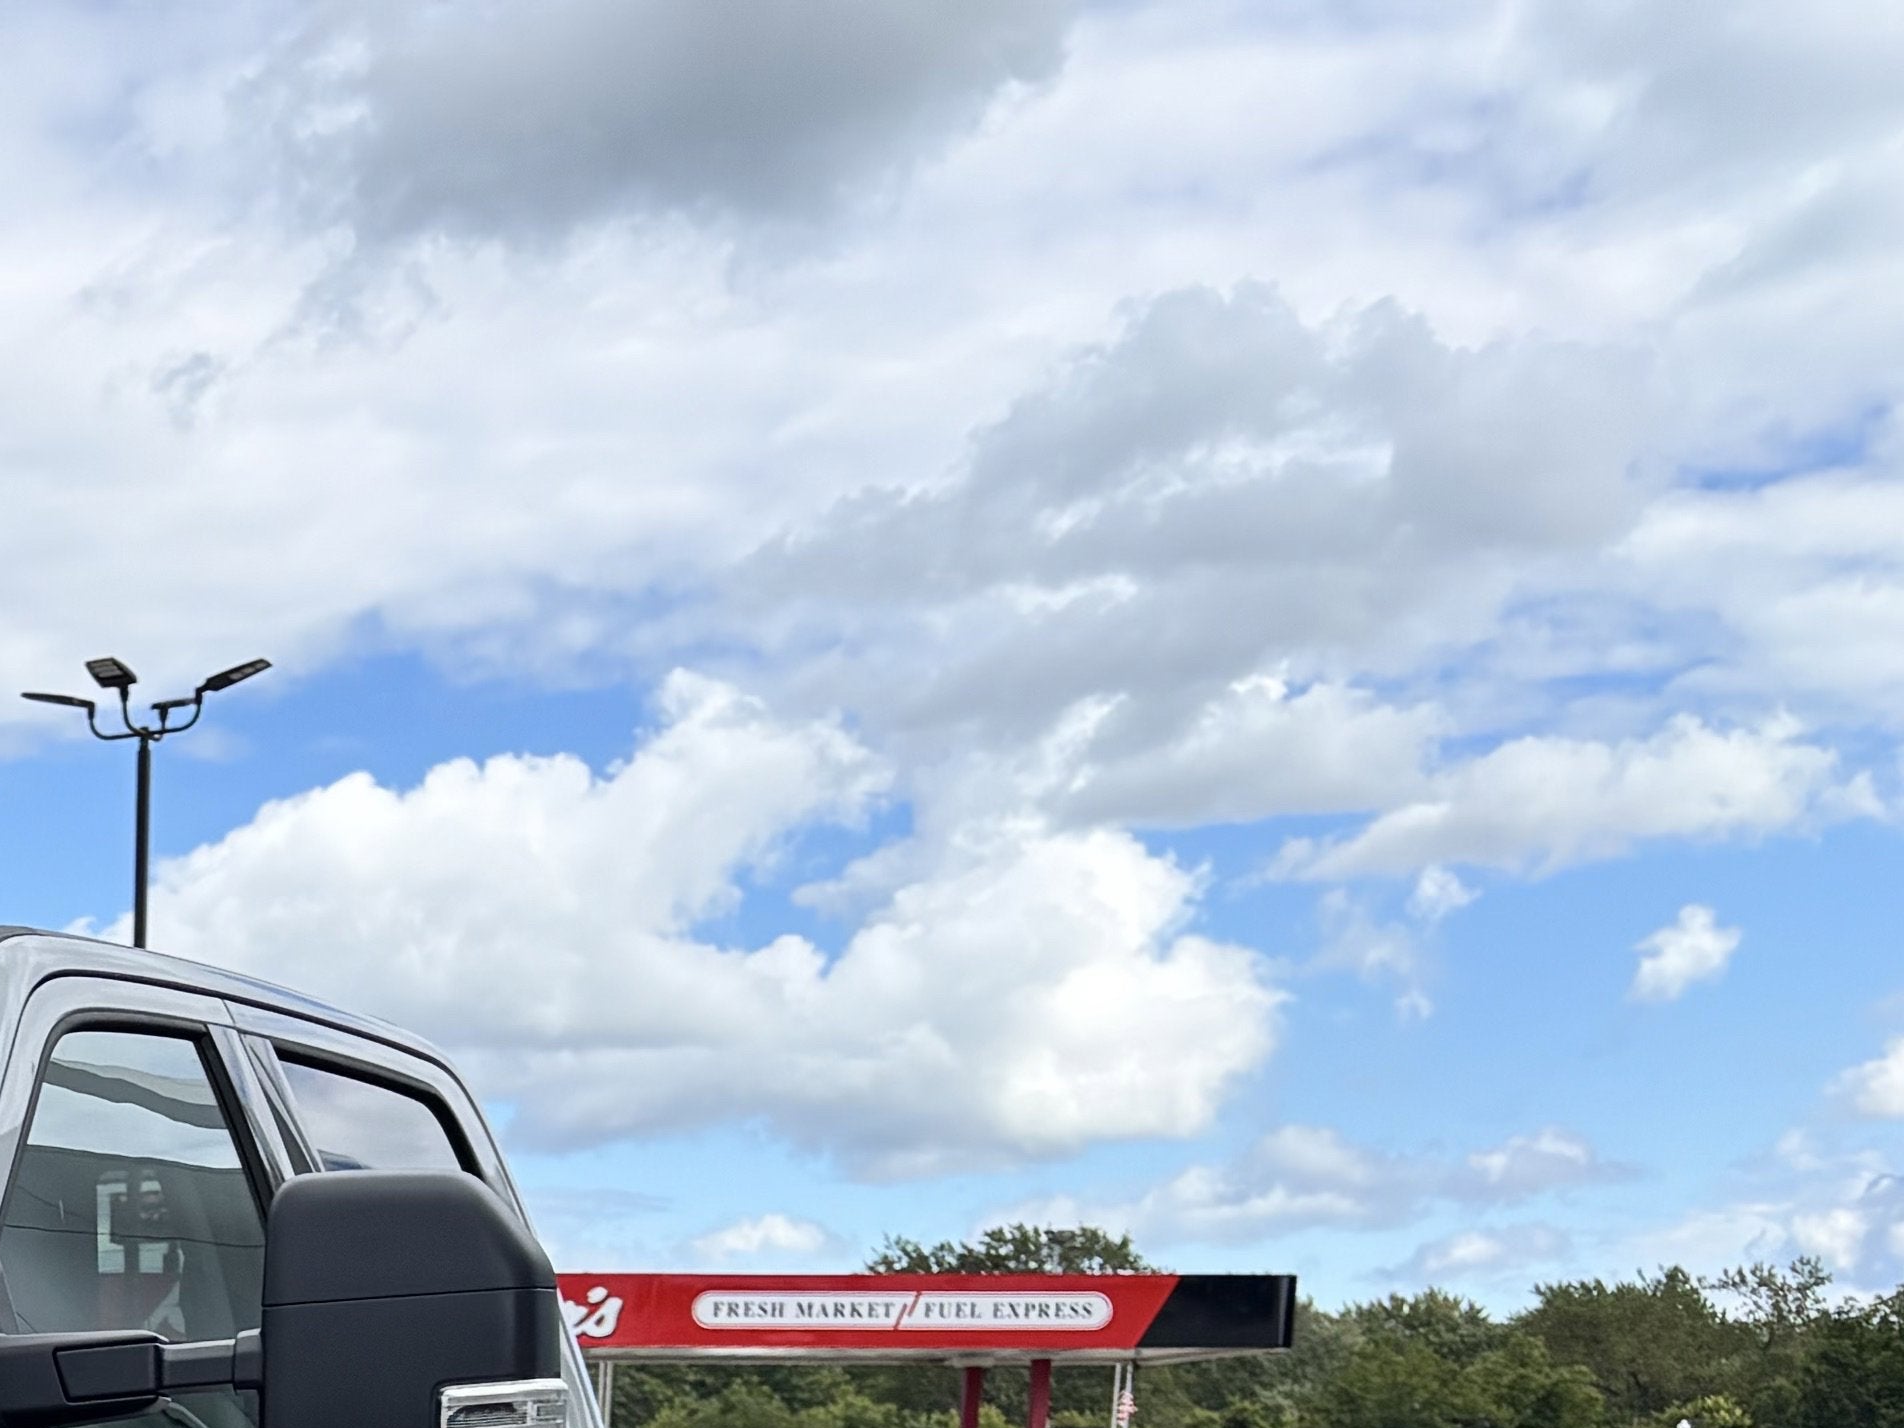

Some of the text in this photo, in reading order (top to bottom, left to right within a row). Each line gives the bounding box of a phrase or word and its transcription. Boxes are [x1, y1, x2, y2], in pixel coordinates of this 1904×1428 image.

[713, 1301, 1094, 1319] FRESH MARKET FUEL EXPRESS
